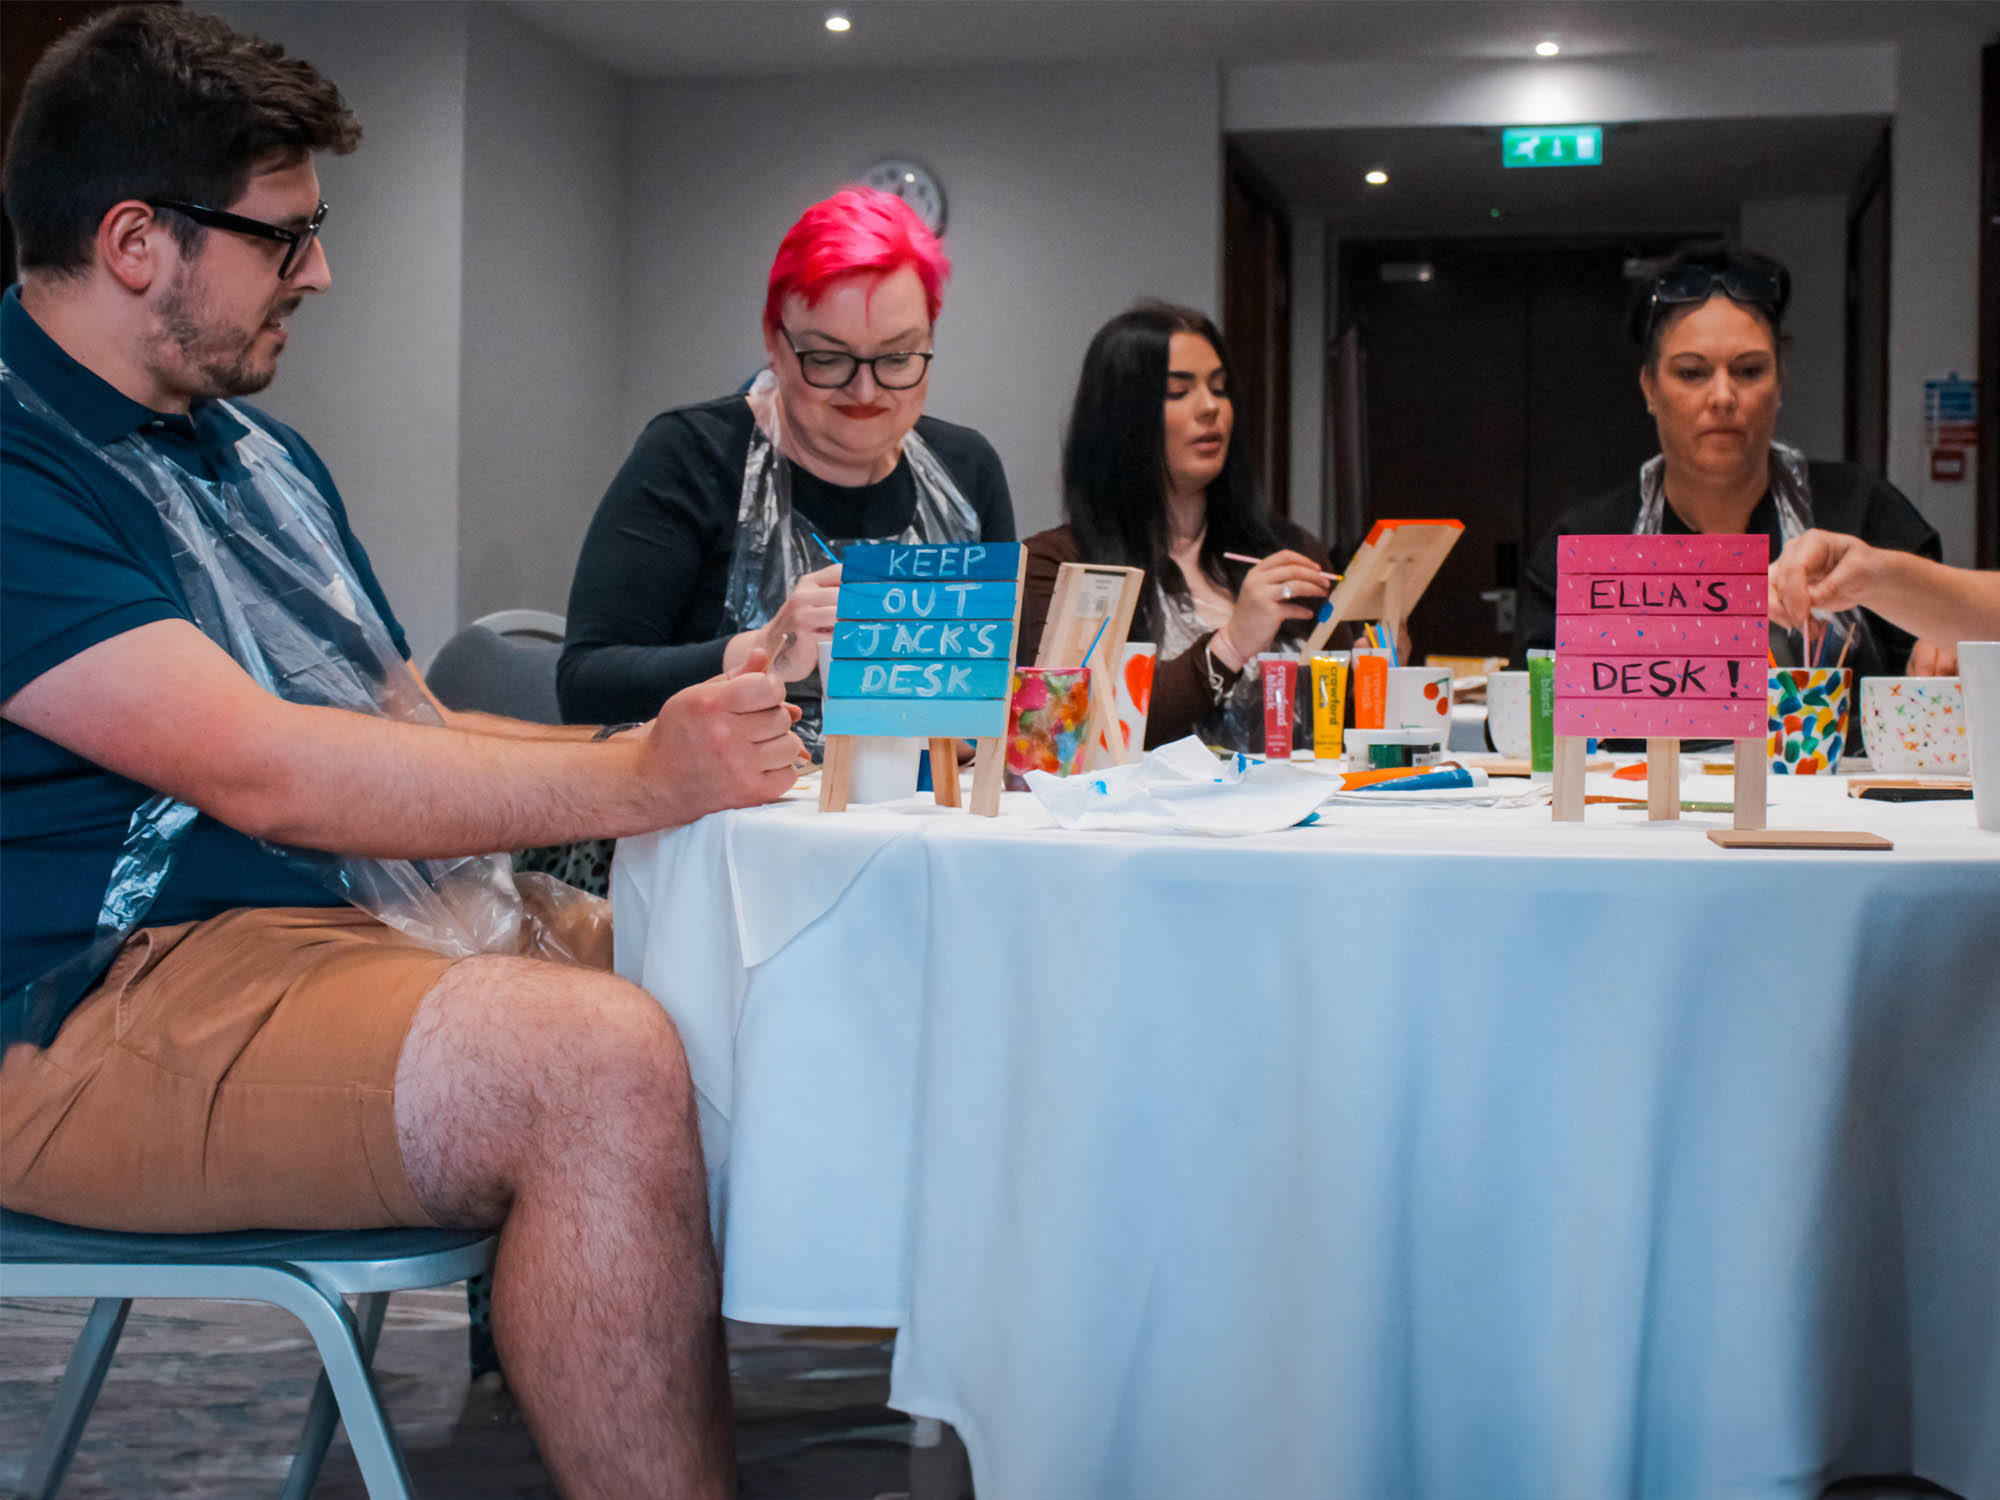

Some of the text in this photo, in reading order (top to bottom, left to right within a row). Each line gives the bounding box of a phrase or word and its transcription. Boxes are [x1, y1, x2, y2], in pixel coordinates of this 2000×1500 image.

[889, 546, 987, 577] KEEP
[882, 583, 983, 618] OUT
[1590, 579, 1729, 612] ELLA'S
[857, 623, 998, 658] JACK'S
[860, 663, 973, 698] DESK
[1329, 666, 1340, 726] crawford
